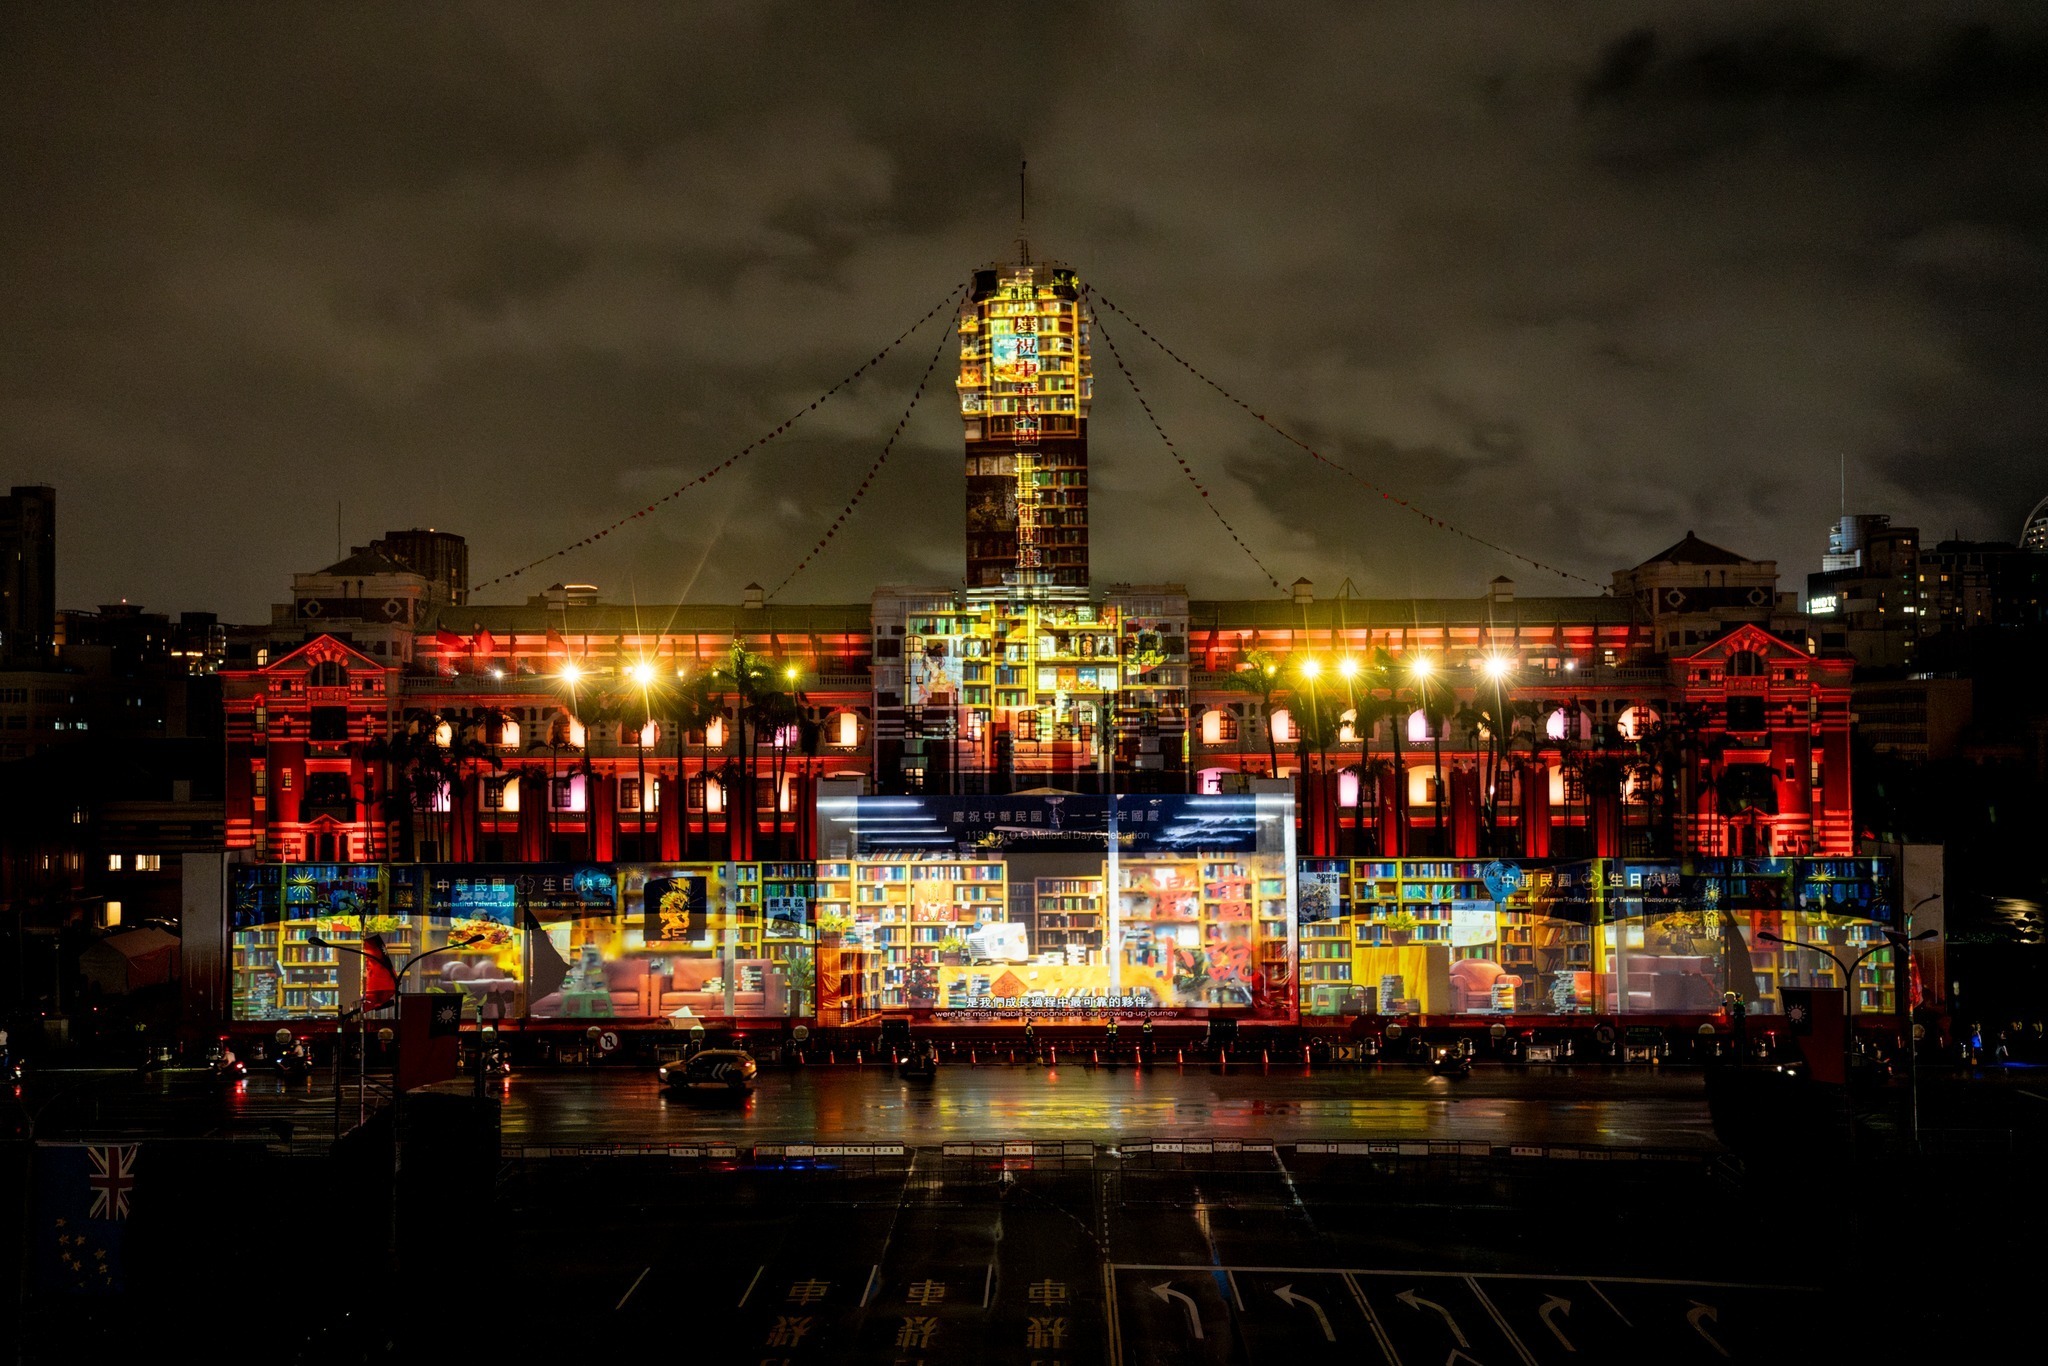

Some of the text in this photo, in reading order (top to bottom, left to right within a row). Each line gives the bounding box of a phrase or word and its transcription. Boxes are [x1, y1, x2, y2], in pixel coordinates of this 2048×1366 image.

[952, 810, 1043, 823] 慶祝中華民國
[1032, 830, 1072, 840] National
[1073, 830, 1092, 842] Day
[1094, 829, 1150, 840] Celebration
[935, 1010, 956, 1018] were
[972, 1010, 992, 1018] most
[993, 1010, 1023, 1018] reliable
[1024, 1010, 1075, 1019] companions
[1085, 1010, 1098, 1018] our
[1100, 1010, 1146, 1019] growing-up
[1147, 1010, 1178, 1019] journey
